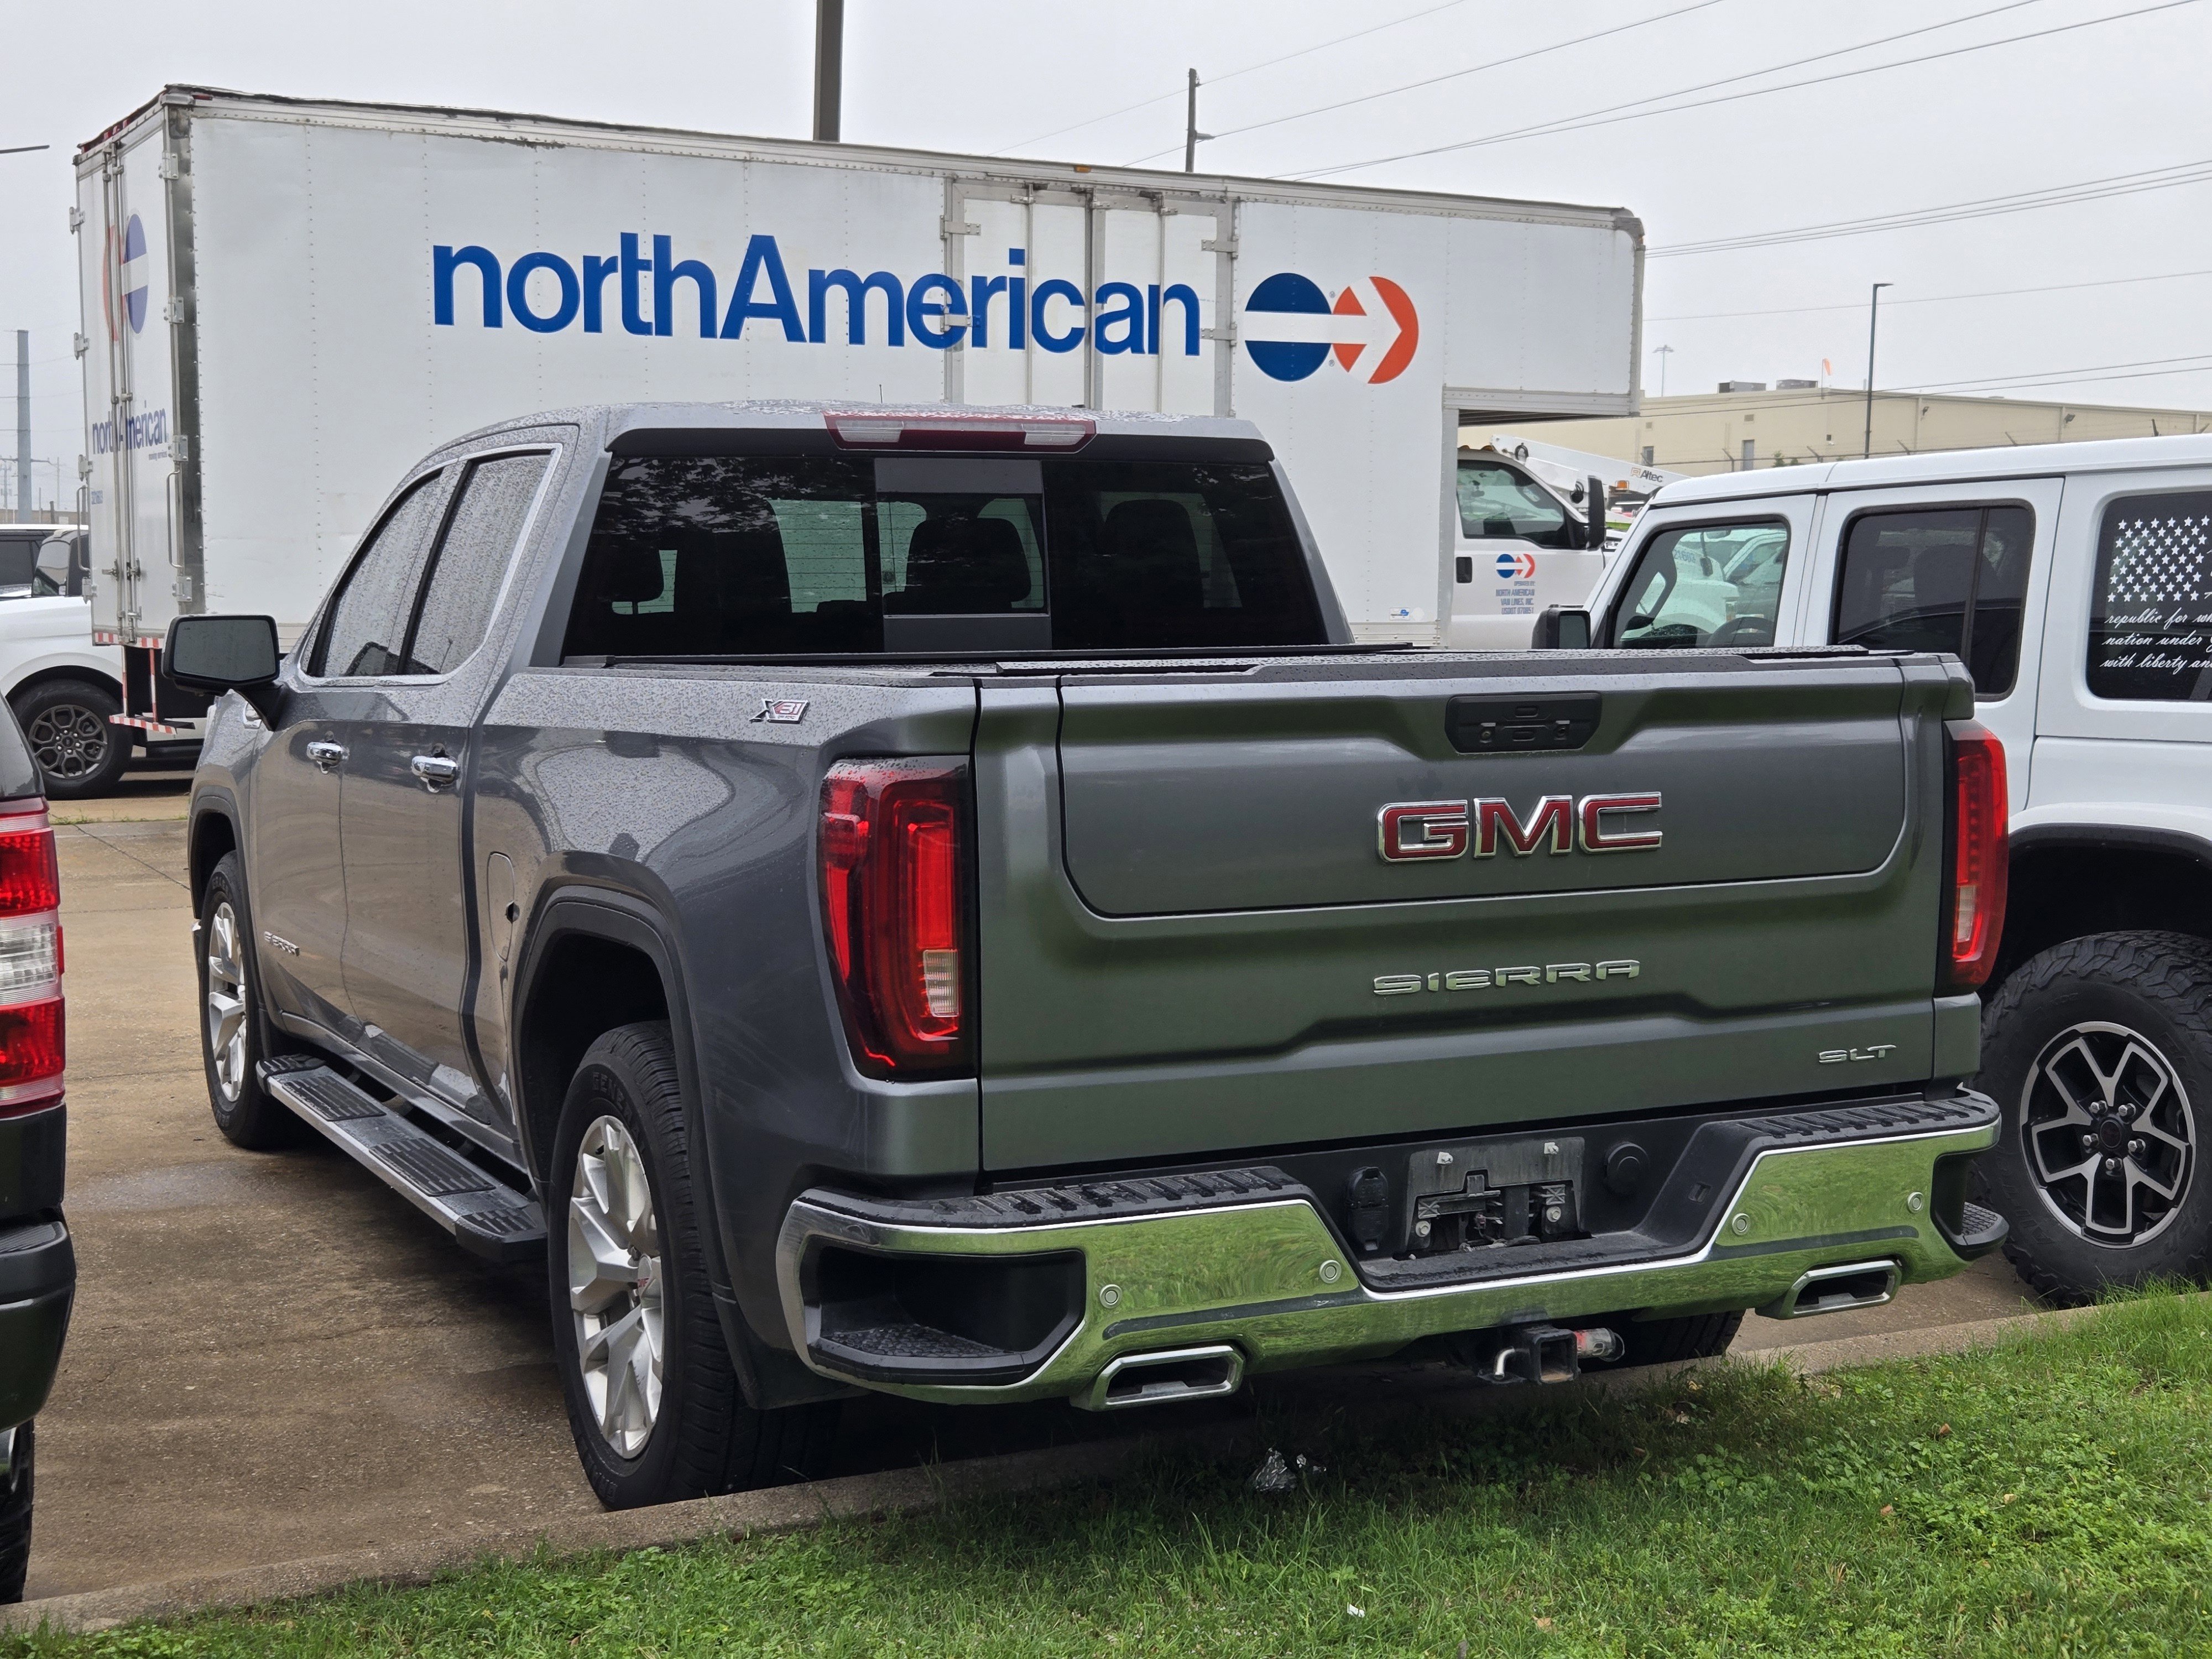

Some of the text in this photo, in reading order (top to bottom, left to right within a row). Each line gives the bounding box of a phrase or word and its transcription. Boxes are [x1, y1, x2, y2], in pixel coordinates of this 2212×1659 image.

[433, 232, 1200, 356] northAmerican
[1640, 470, 1663, 482] Altec
[2104, 608, 2162, 629] republic
[2163, 607, 2188, 630] for
[2102, 632, 2153, 645] nation
[2156, 630, 2203, 645] under
[2099, 653, 2137, 667] with
[2135, 653, 2188, 675] liberty
[1376, 791, 1662, 863] GMC
[1374, 959, 1641, 995] SIERRA
[1819, 1045, 1897, 1063] SLT
